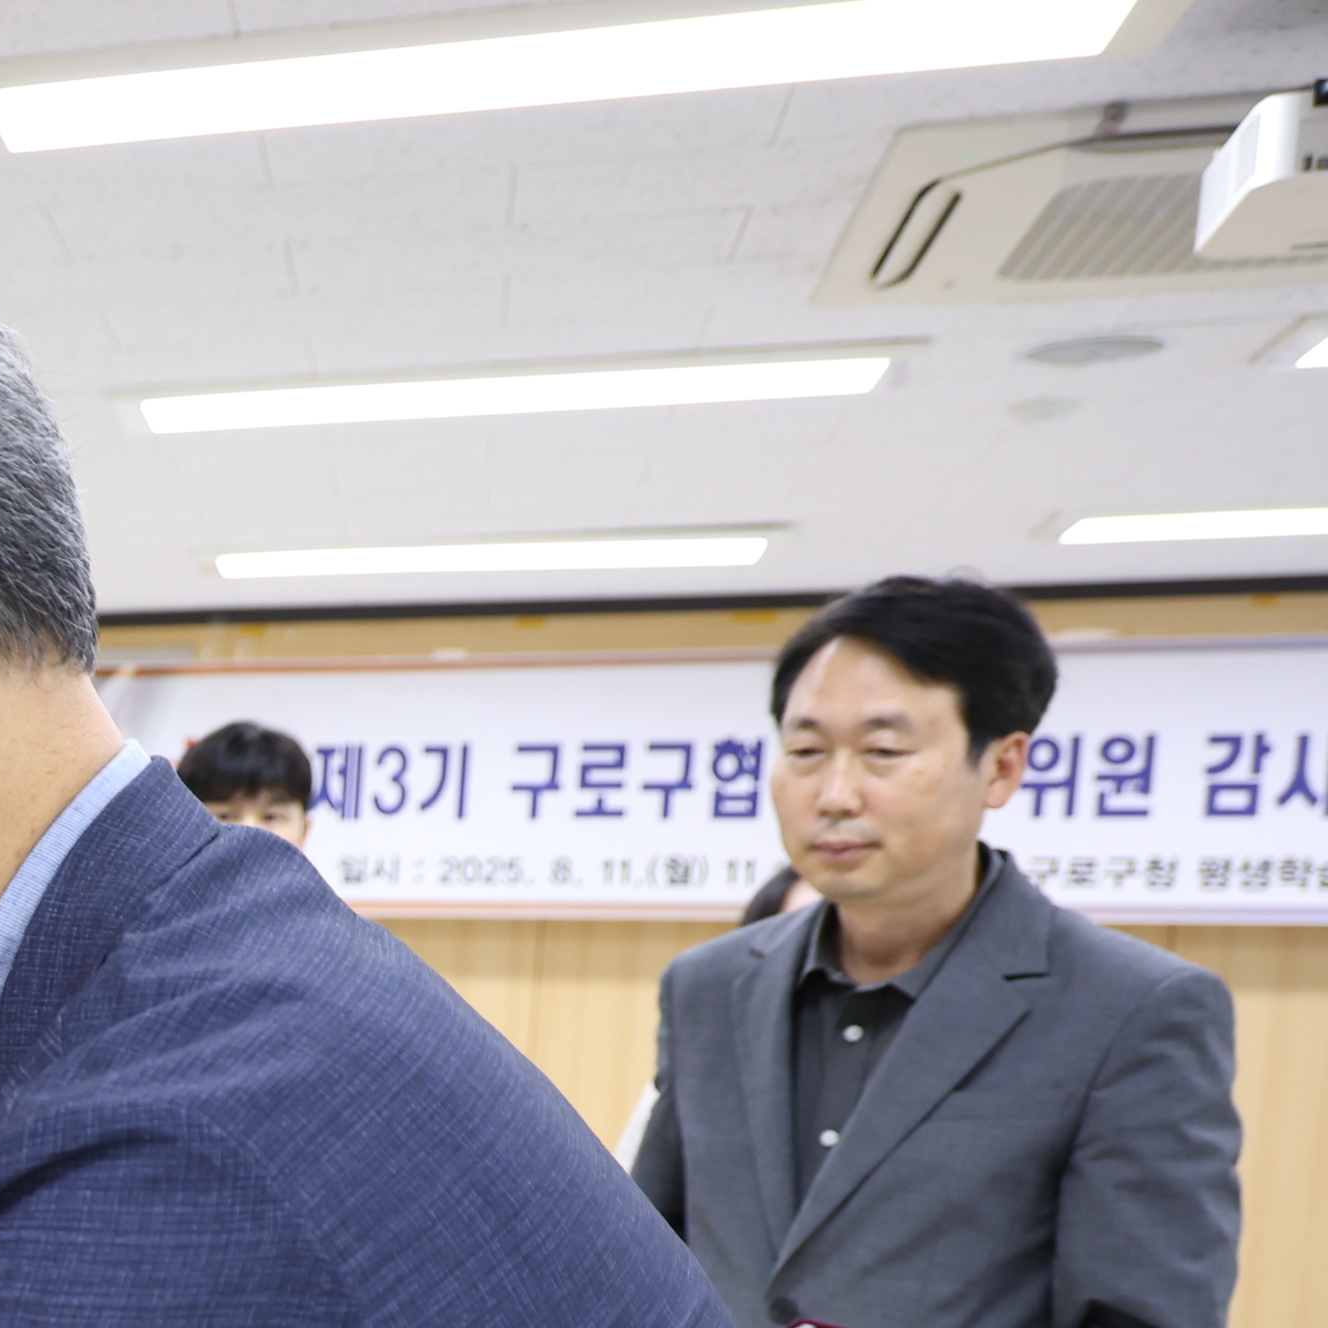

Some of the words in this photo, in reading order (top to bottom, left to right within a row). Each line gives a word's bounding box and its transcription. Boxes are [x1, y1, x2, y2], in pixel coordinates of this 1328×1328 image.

[307, 742, 468, 820] 제3기
[511, 738, 763, 820] 구로구협
[1021, 734, 1156, 818] 위원
[339, 854, 400, 885] 일시
[439, 855, 535, 887] 2025.
[549, 856, 583, 886] 8.
[1027, 855, 1180, 891] 구로구청
